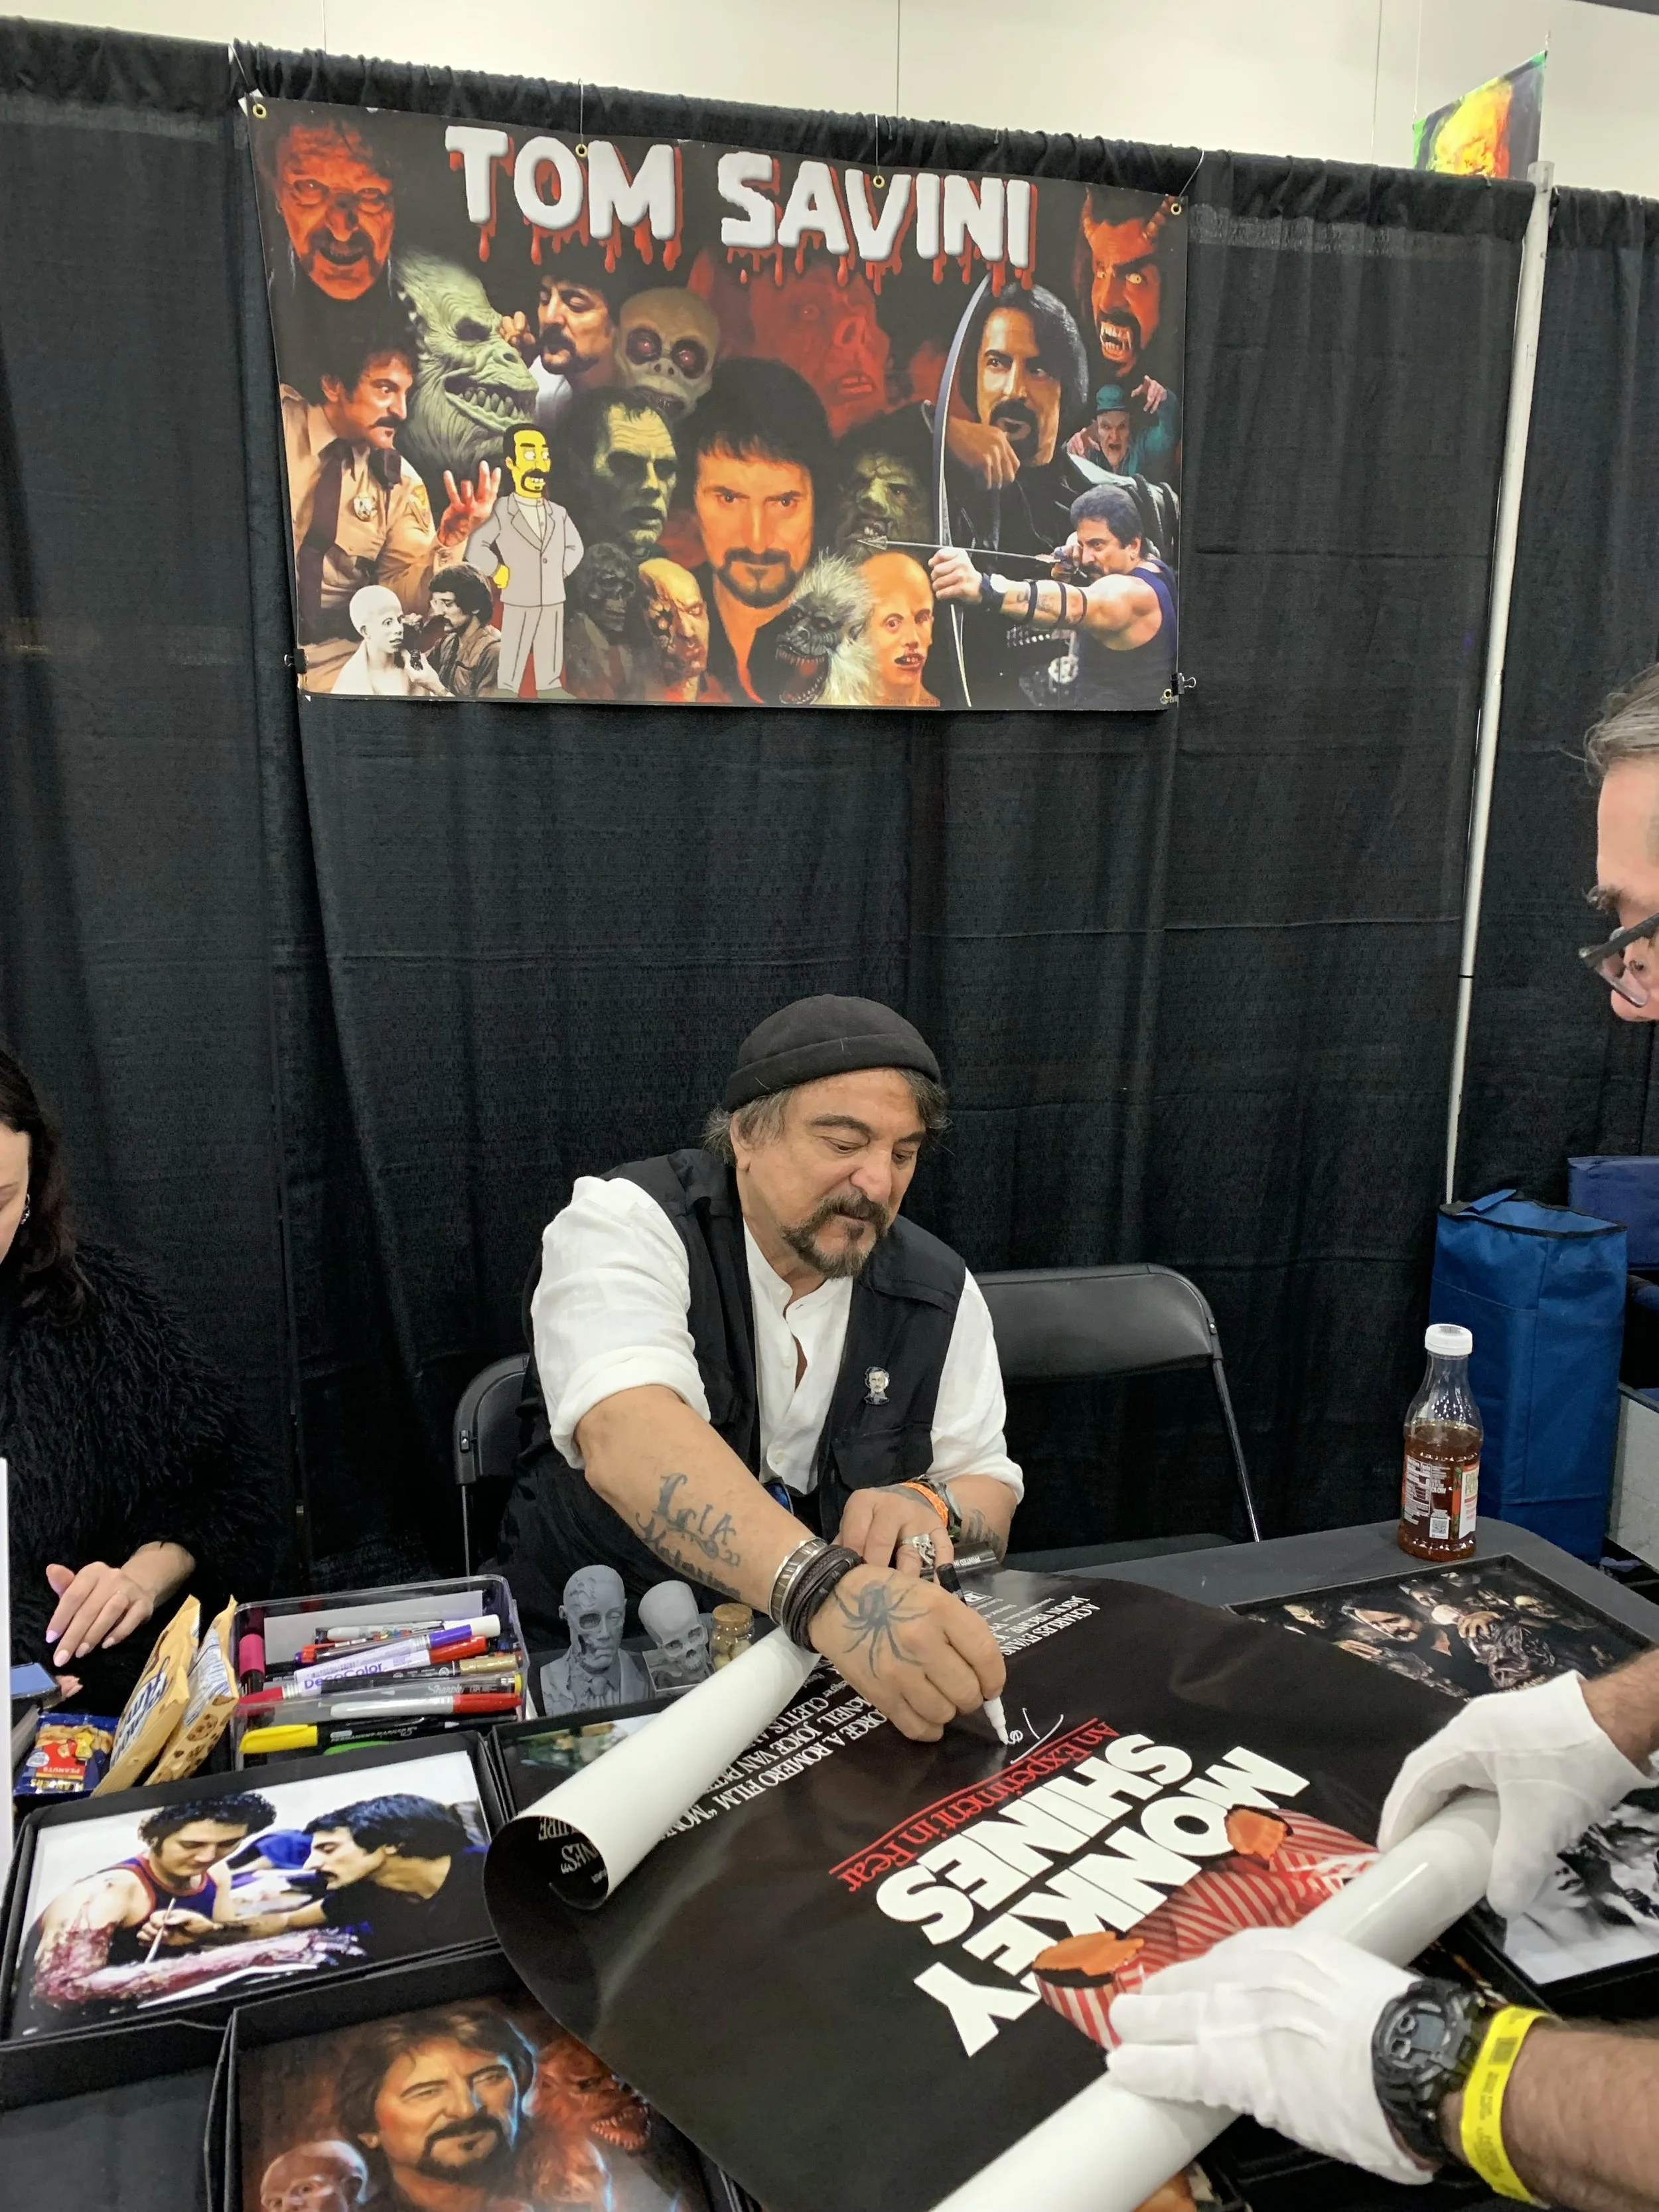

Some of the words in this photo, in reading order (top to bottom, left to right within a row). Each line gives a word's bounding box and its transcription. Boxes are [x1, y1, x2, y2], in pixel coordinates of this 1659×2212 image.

[445, 125, 676, 240] TOM
[718, 151, 1032, 269] SAVINI
[1045, 1595, 1090, 1615] JASON
[1032, 1607, 1093, 1637] CHARLES
[999, 1633, 1043, 1656] EVANS
[823, 1680, 848, 1698] esigner
[769, 1721, 823, 1755] JOYCE
[838, 1709, 888, 1741] ORGE
[1074, 1720, 1120, 1747] An
[736, 1750, 780, 1774] VAN
[758, 1741, 833, 1787] ROMERO
[711, 1779, 767, 1810] FILM
[930, 1744, 1093, 1830] Experiment
[876, 1733, 1192, 1945] SHINES
[898, 1820, 948, 1844] in
[837, 1840, 918, 1893] Fear
[913, 1745, 1310, 2057] MONKEY
